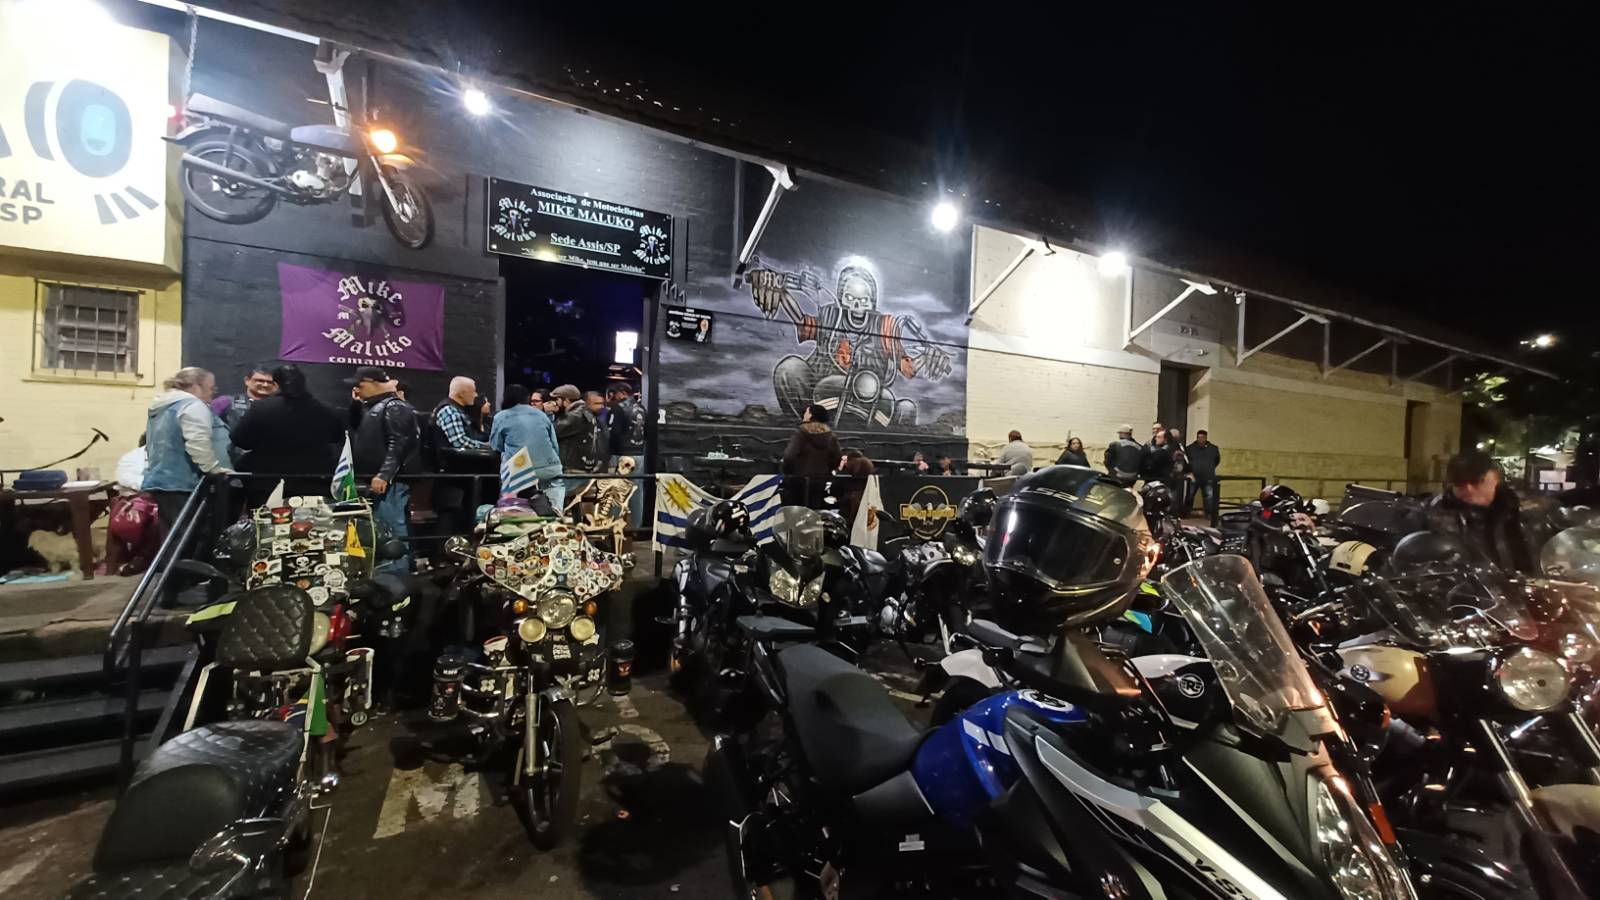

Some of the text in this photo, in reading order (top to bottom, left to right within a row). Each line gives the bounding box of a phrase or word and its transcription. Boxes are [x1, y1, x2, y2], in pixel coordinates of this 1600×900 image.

[498, 197, 533, 215] Mike
[530, 188, 645, 218] Associação de Motociclistas
[538, 200, 635, 229] MIKE MALUKO
[490, 223, 537, 242] Maluko
[639, 224, 668, 240] Mike
[550, 232, 621, 254] Sede Assis/SP
[631, 248, 671, 265] Maluko
[337, 275, 403, 304] Mike
[320, 327, 413, 357] Maluko
[328, 356, 406, 368] comando
[1020, 486, 1079, 502] LS2
